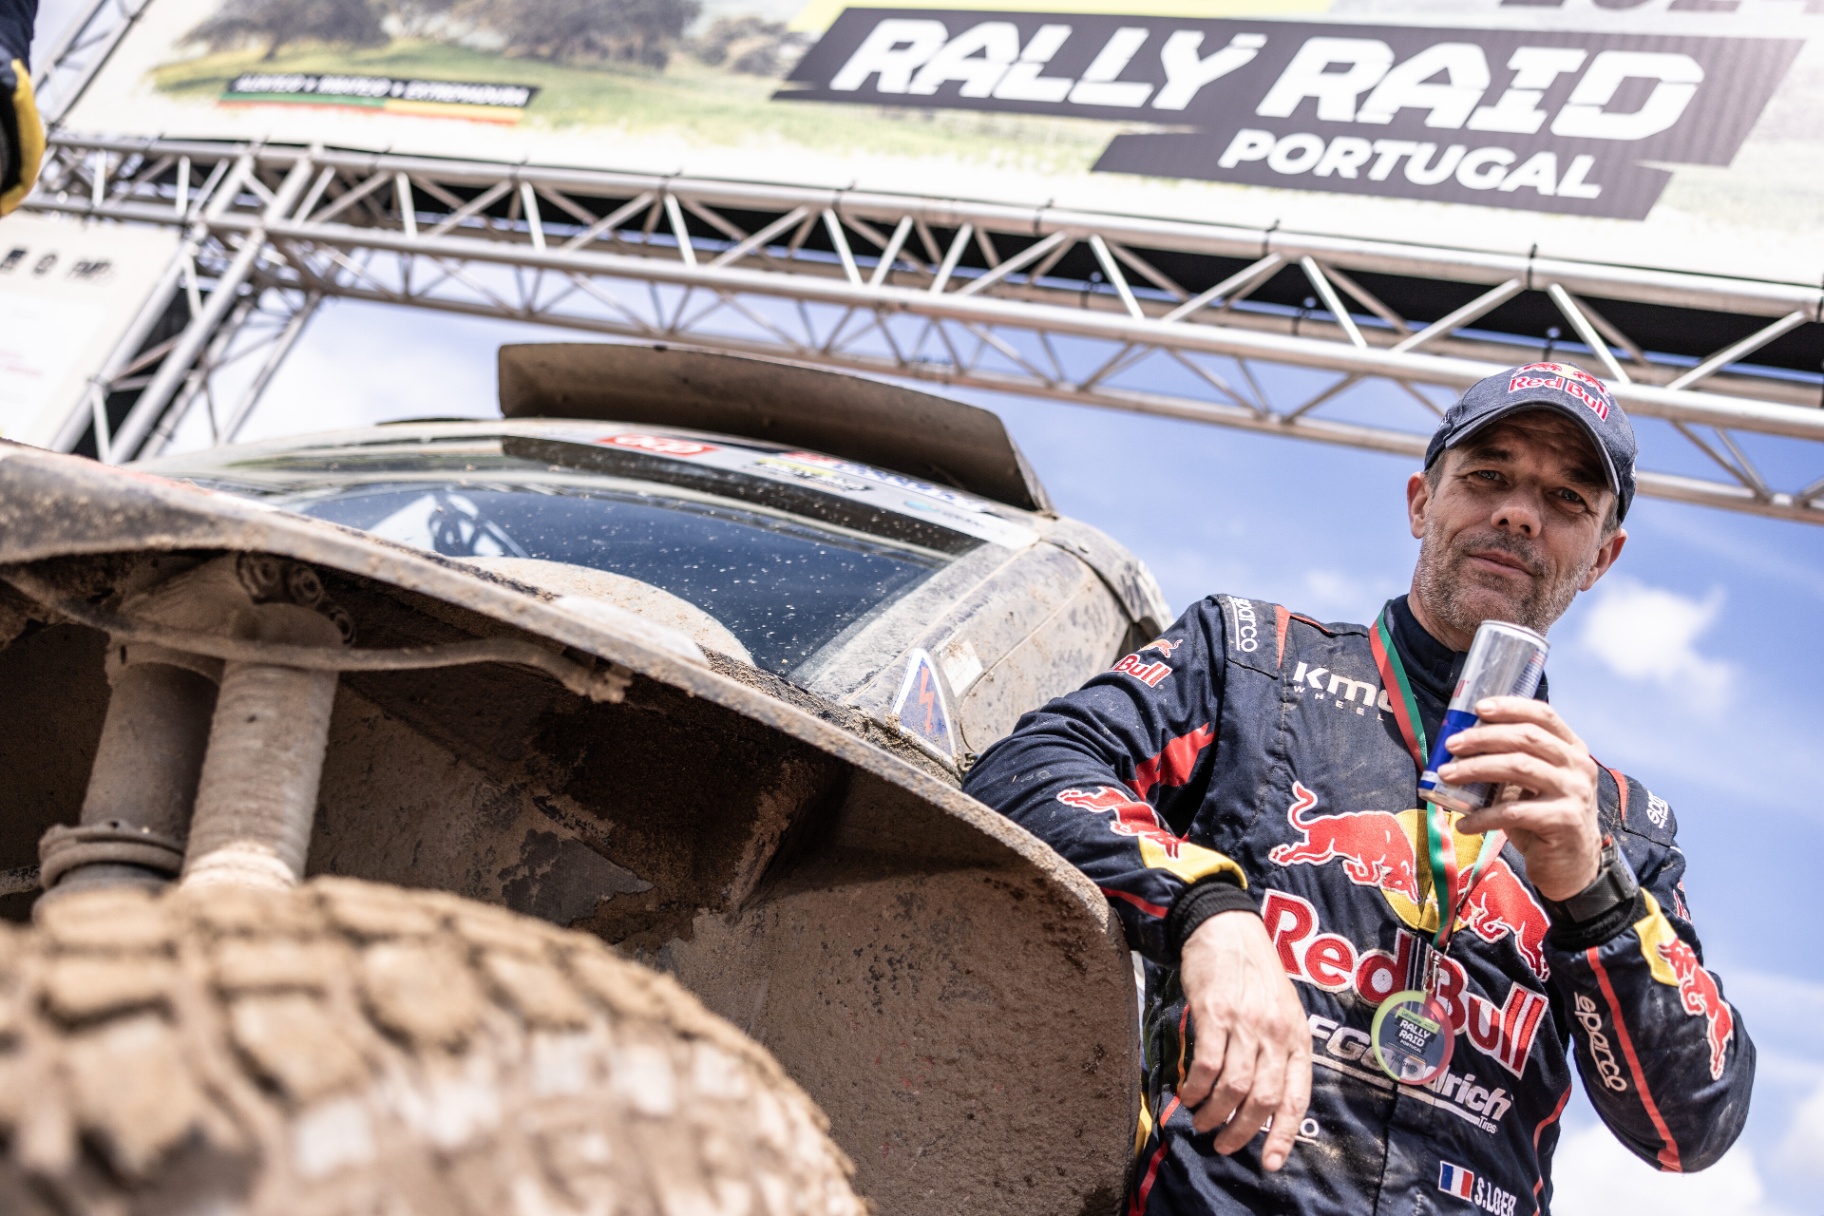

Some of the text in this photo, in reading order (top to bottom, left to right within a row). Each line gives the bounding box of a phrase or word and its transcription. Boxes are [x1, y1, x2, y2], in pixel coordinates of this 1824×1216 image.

[829, 18, 1706, 141] RALLY RAID
[1218, 128, 1602, 200] PORTUGAL
[1508, 376, 1610, 422] Red Bull
[1110, 653, 1173, 688] Bull
[1262, 888, 1549, 1081] Red Bull
[1398, 1029, 1425, 1048] RAID
[1399, 1019, 1431, 1039] RALLY
[1480, 1115, 1498, 1135] Tires
